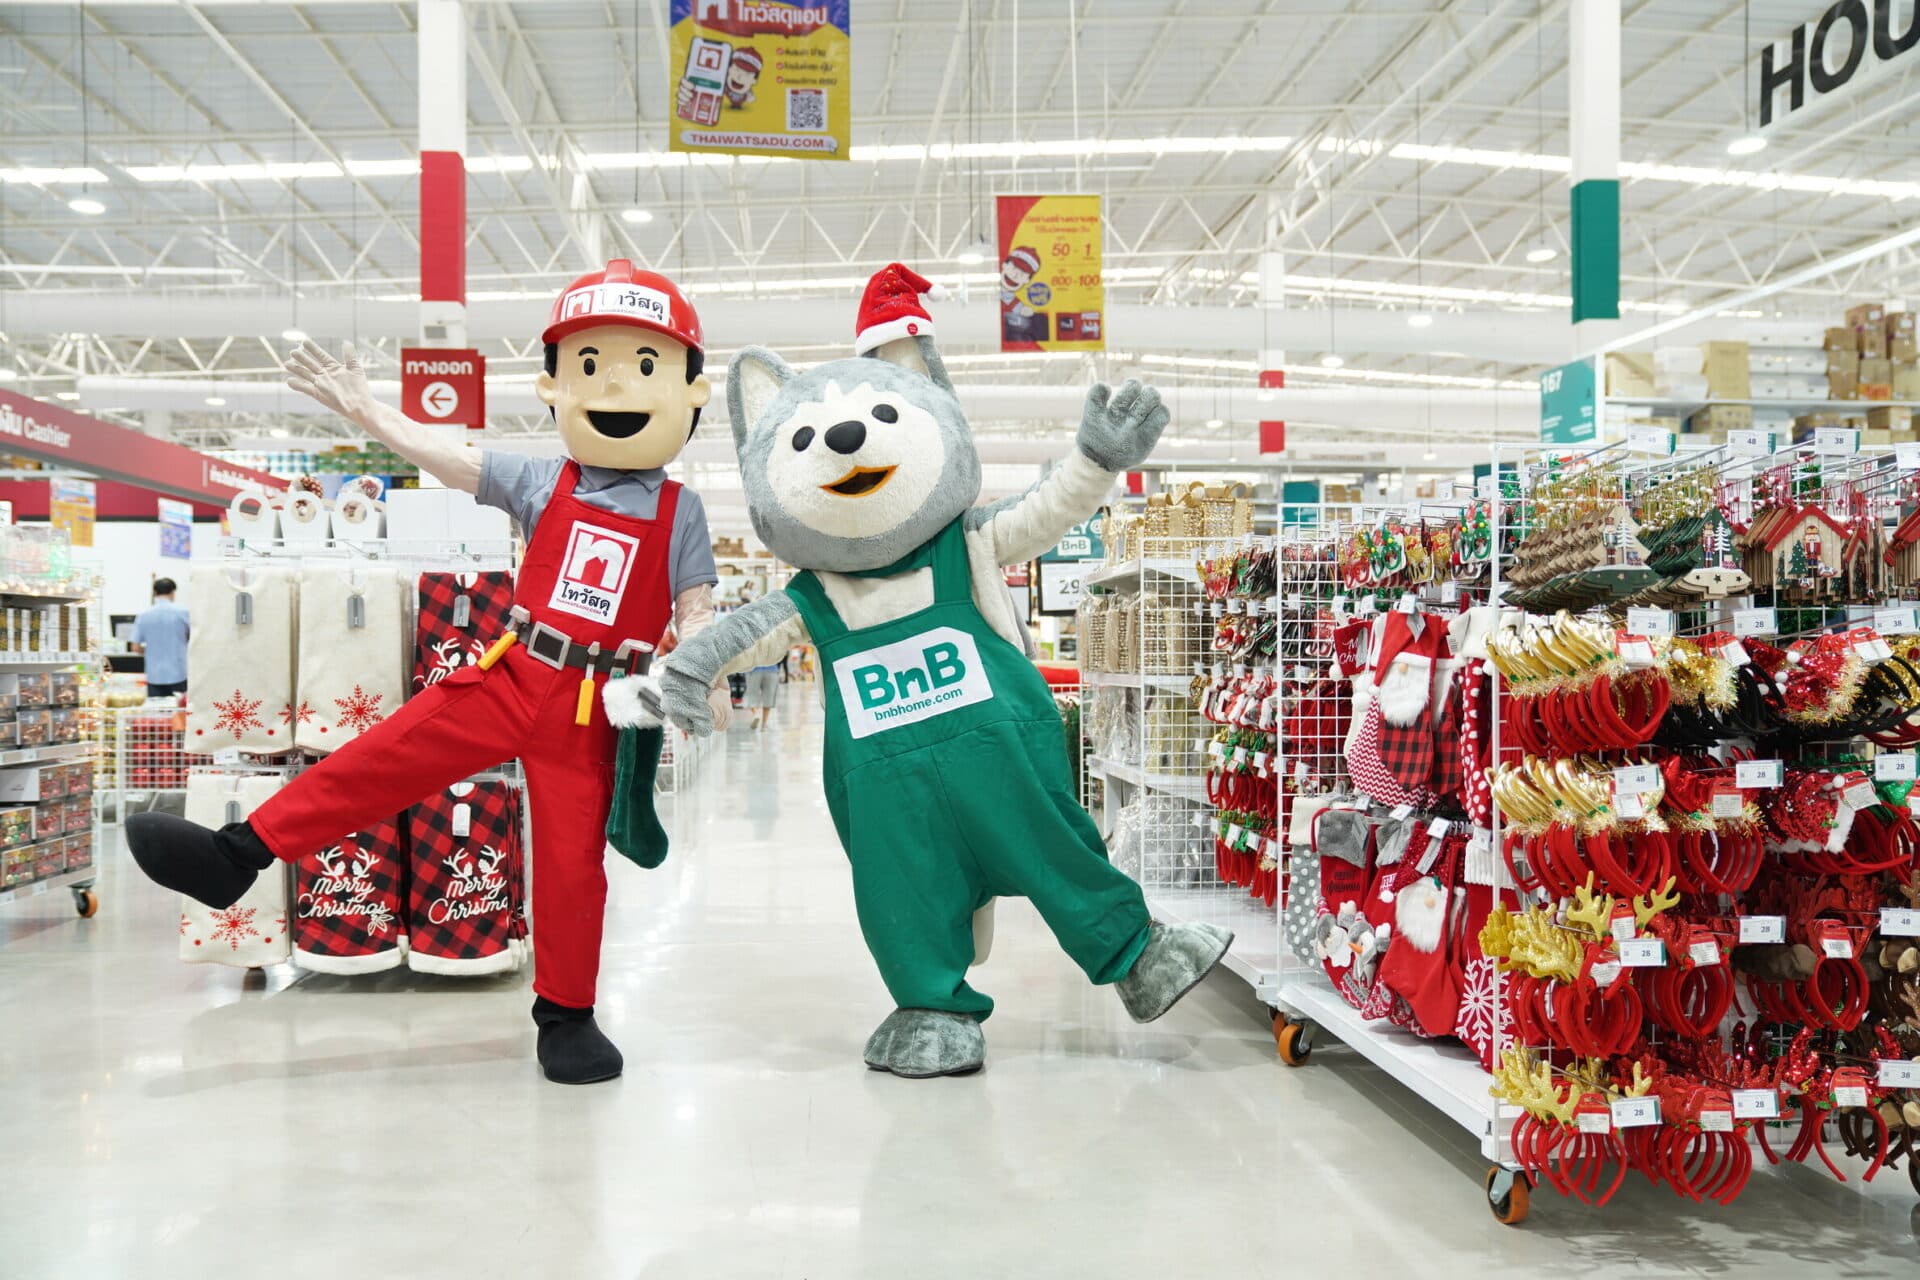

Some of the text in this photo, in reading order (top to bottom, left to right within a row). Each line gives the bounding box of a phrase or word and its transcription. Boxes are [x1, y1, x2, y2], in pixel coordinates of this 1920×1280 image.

[691, 134, 824, 148] THAIWATSADU.COM
[406, 361, 473, 375] ทางออก
[1542, 370, 1563, 394] 167
[24, 416, 71, 448] Cashier
[1062, 540, 1087, 550] BnB
[561, 580, 611, 616] ไทวัสดุ
[852, 642, 966, 710] BnB
[874, 688, 963, 721] bnbhome.com
[312, 876, 376, 903] Merry
[297, 893, 391, 918] Christmas
